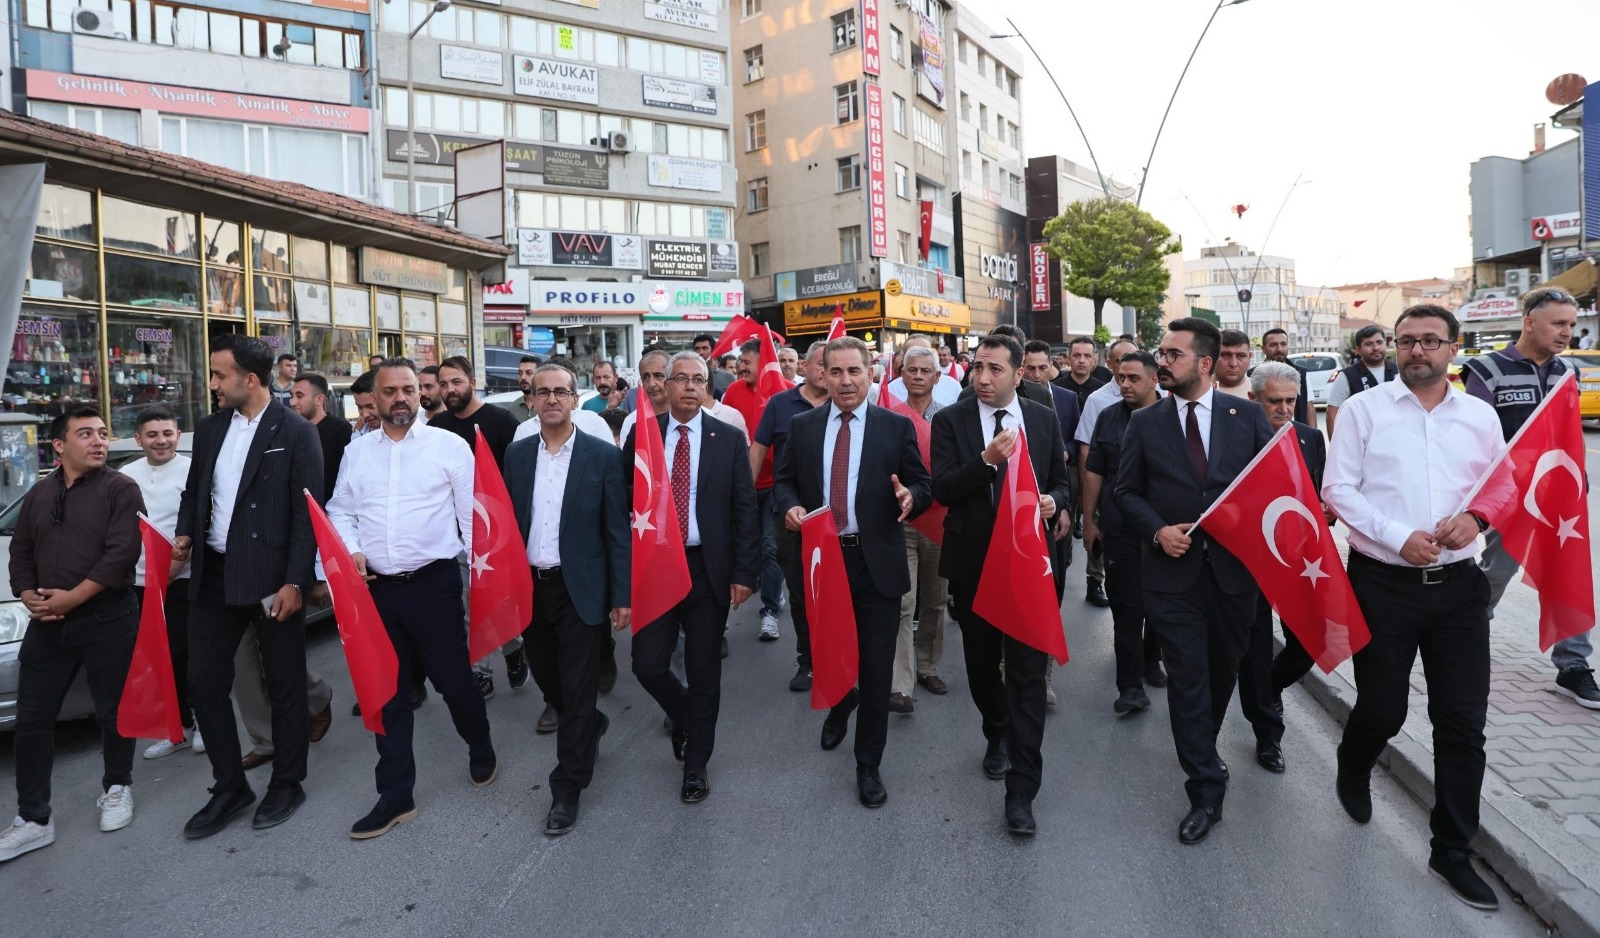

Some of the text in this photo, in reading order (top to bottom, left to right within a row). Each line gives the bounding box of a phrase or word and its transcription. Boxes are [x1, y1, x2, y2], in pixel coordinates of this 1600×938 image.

[538, 61, 596, 82] AVUKAT
[57, 75, 128, 97] Gelinlik
[519, 76, 595, 96] ELİF ZÜLAL BAYRAM
[869, 90, 882, 172] SÜRÜCÜ
[506, 147, 537, 161] ŞAAT
[546, 156, 588, 167] PSİKOLOJİ
[872, 179, 885, 246] KURSU
[557, 231, 608, 254] VAV
[655, 243, 702, 254] ELEKTRİK
[650, 252, 706, 263] MÜHENDİSİ
[654, 262, 676, 270] MURAT
[980, 244, 1018, 283] bambi
[372, 269, 392, 282] SÜT
[814, 268, 840, 283] EREĞLİ
[907, 271, 928, 297] PARTİ
[801, 279, 854, 296] İLÇE BAŞKANLIĞI
[989, 286, 1012, 301] YATAK
[675, 288, 743, 308] ÇİMEN ET
